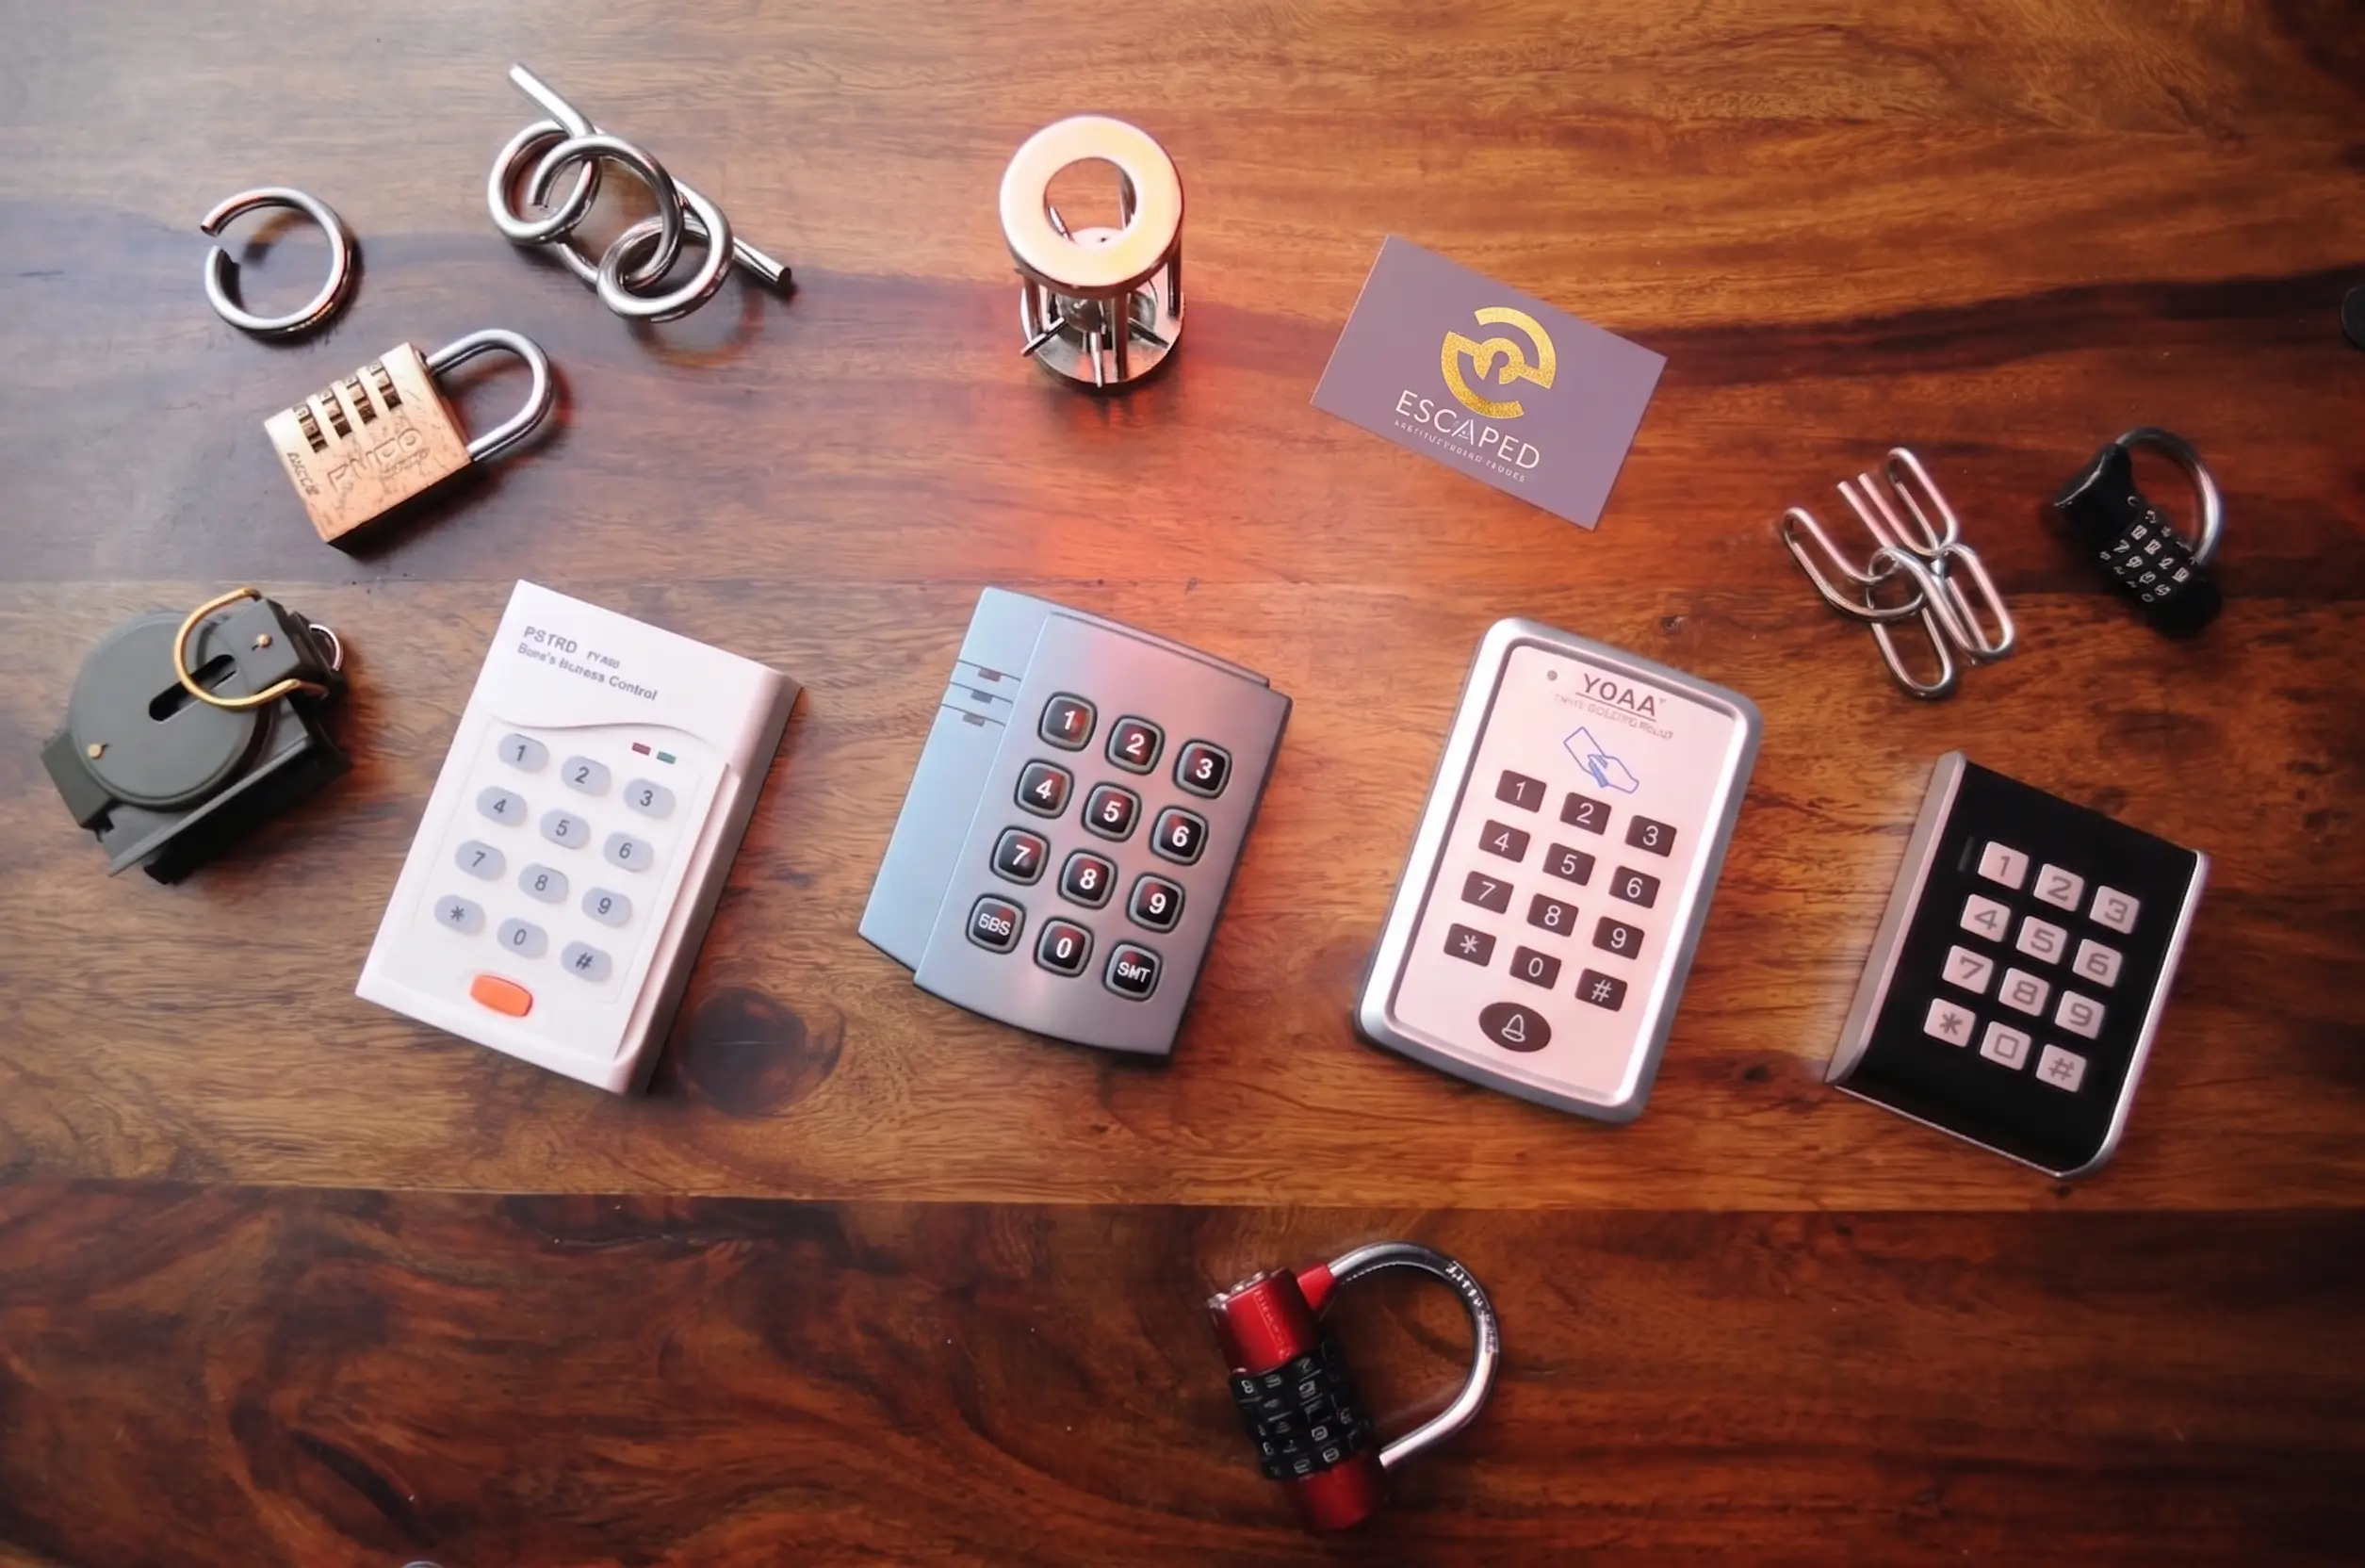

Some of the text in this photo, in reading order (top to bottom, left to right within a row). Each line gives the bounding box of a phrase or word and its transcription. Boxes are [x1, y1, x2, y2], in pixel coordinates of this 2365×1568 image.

[1395, 389, 1541, 469] ESCAPED
[524, 626, 578, 653] PSTRD
[609, 676, 658, 701] Control
[1584, 673, 1656, 716] YOAA
[516, 745, 653, 806] 1 2 3
[1065, 711, 1213, 778] 1 2 3
[494, 799, 632, 858] 4 5 6
[1036, 779, 1189, 846] 4 5 6
[1515, 782, 1658, 845] 1 2 3
[473, 851, 612, 914] 7 8 9
[1013, 844, 1166, 913] 7 8 9
[1494, 833, 1642, 897] 4 5 6
[1998, 856, 2128, 923] 1 2 3
[1479, 881, 1626, 948] 7 8 9
[1974, 909, 2109, 976] 4 5 6
[514, 929, 527, 945] 0
[577, 954, 592, 969] #
[1057, 938, 1072, 957] 0
[1529, 957, 1542, 976] 0
[1591, 980, 1611, 1002] #
[1960, 956, 2093, 1027] 7 8 9
[1994, 1034, 2019, 1059] 0
[2048, 1058, 2075, 1081] #
